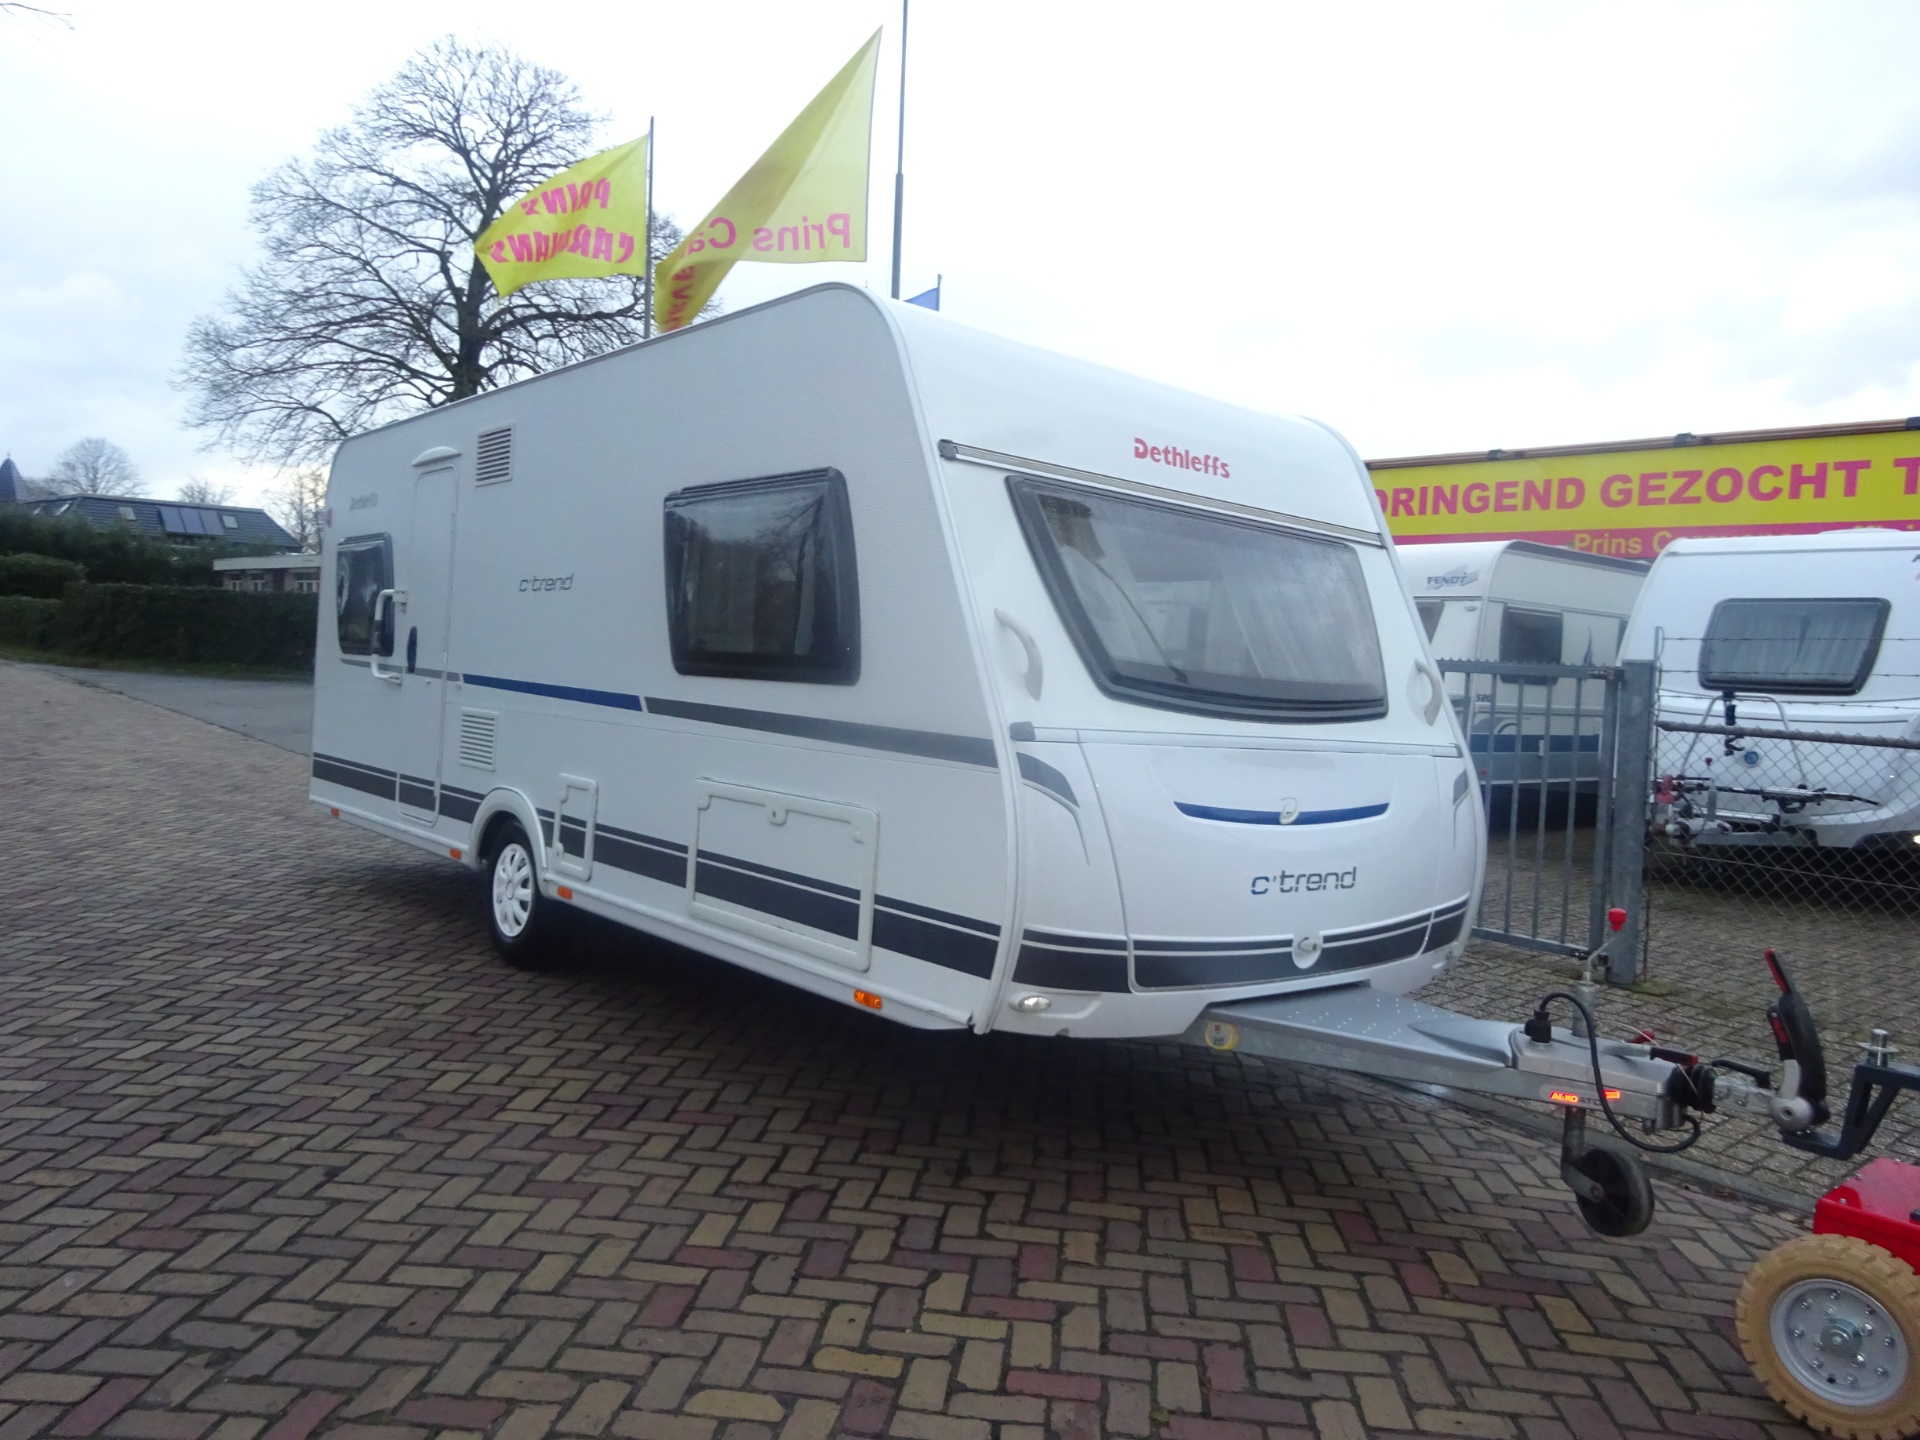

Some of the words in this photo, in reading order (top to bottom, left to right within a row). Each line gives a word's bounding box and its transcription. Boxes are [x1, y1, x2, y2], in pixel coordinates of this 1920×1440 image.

[1134, 437, 1230, 479] Dethleffs
[1600, 460, 1871, 508] GEZOCHT
[1574, 532, 1642, 555] Prins
[1427, 576, 1468, 585] FENDT
[1251, 866, 1356, 895] c'trend
